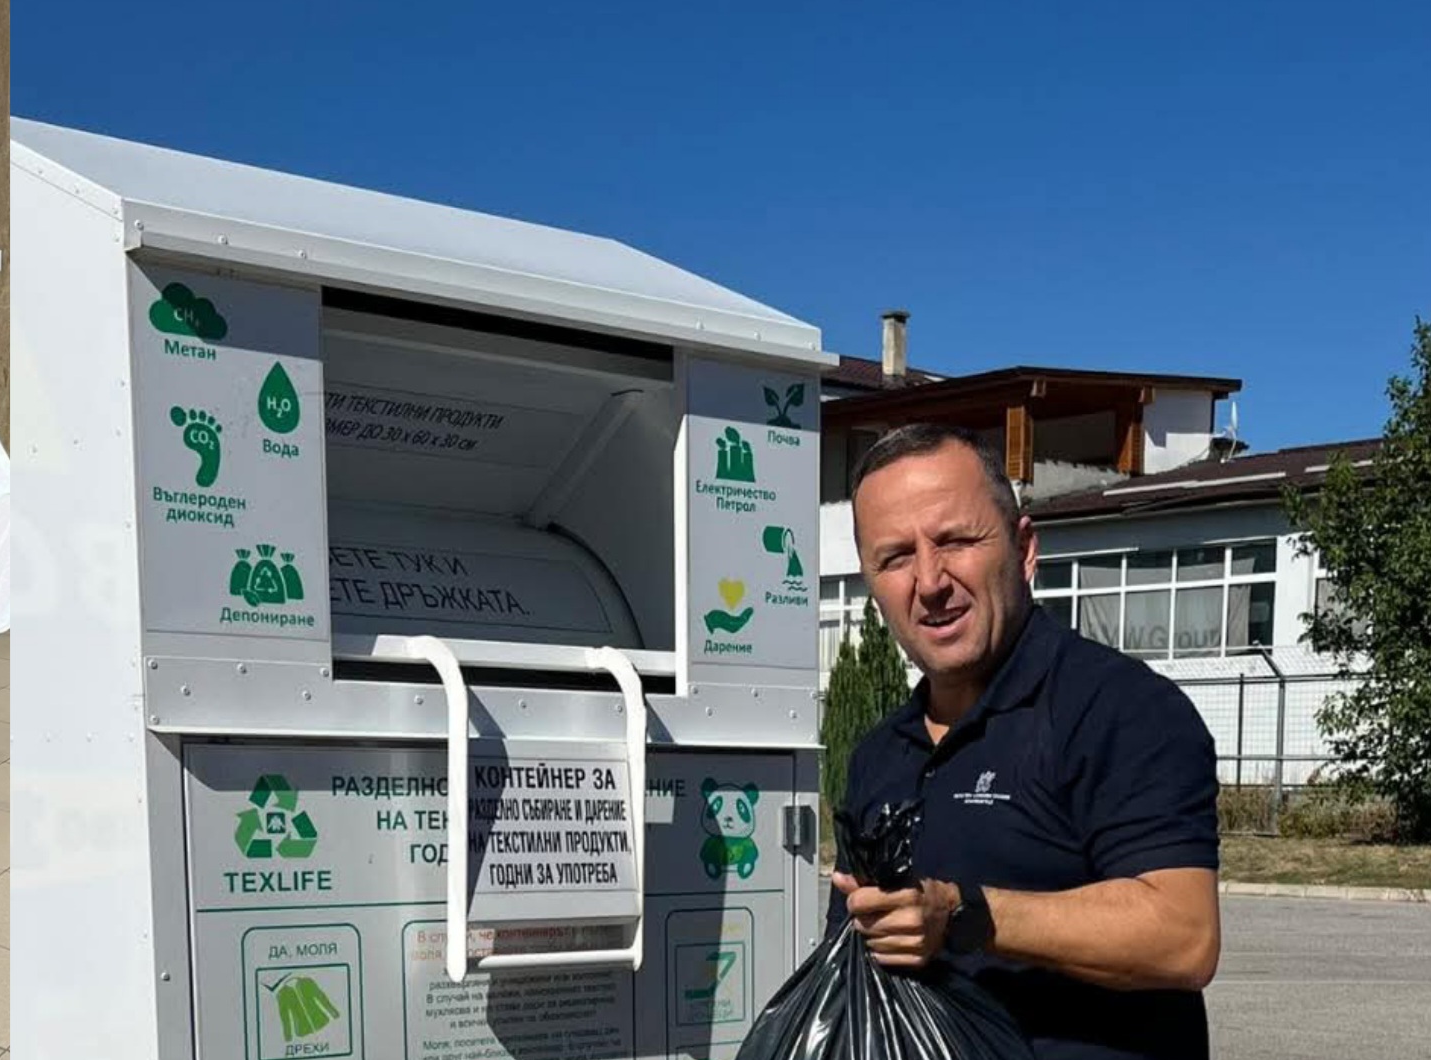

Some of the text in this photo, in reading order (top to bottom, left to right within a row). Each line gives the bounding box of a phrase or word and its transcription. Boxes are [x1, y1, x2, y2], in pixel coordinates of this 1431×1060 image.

[164, 339, 217, 360] Метан
[347, 395, 431, 421] ТЕКСТИЛНИ
[430, 407, 504, 430] ПРОДУКТИ
[357, 424, 383, 440] ДО
[767, 429, 801, 447] Почва
[262, 438, 300, 457] Вода
[152, 486, 247, 512] Въглероден
[695, 479, 777, 502] Електричество
[716, 496, 757, 513] Петрол
[166, 507, 235, 528] диоксид
[329, 547, 468, 577] ЕТЕ ТУК И
[379, 581, 531, 615] ДРЪЖКАТА.
[765, 590, 808, 606] Разливи
[220, 606, 316, 628] Депониране
[703, 638, 753, 654] Дарение
[474, 763, 617, 790] КОНТЕЙНЕР ЗА
[376, 810, 408, 830] НА
[522, 799, 573, 821] СЪБИРАНЕ
[575, 799, 583, 820] И
[585, 799, 627, 825] ДАРЕНИЕ
[470, 831, 486, 853] НА
[488, 830, 561, 853] ТЕКСТИЛНИ
[224, 870, 333, 893] TEXLIFE
[489, 862, 618, 888] ГОДНИ ЗА УПОТРЕБА
[296, 942, 338, 957] МОЛЯ
[284, 1042, 330, 1057] ДРЕХИ
